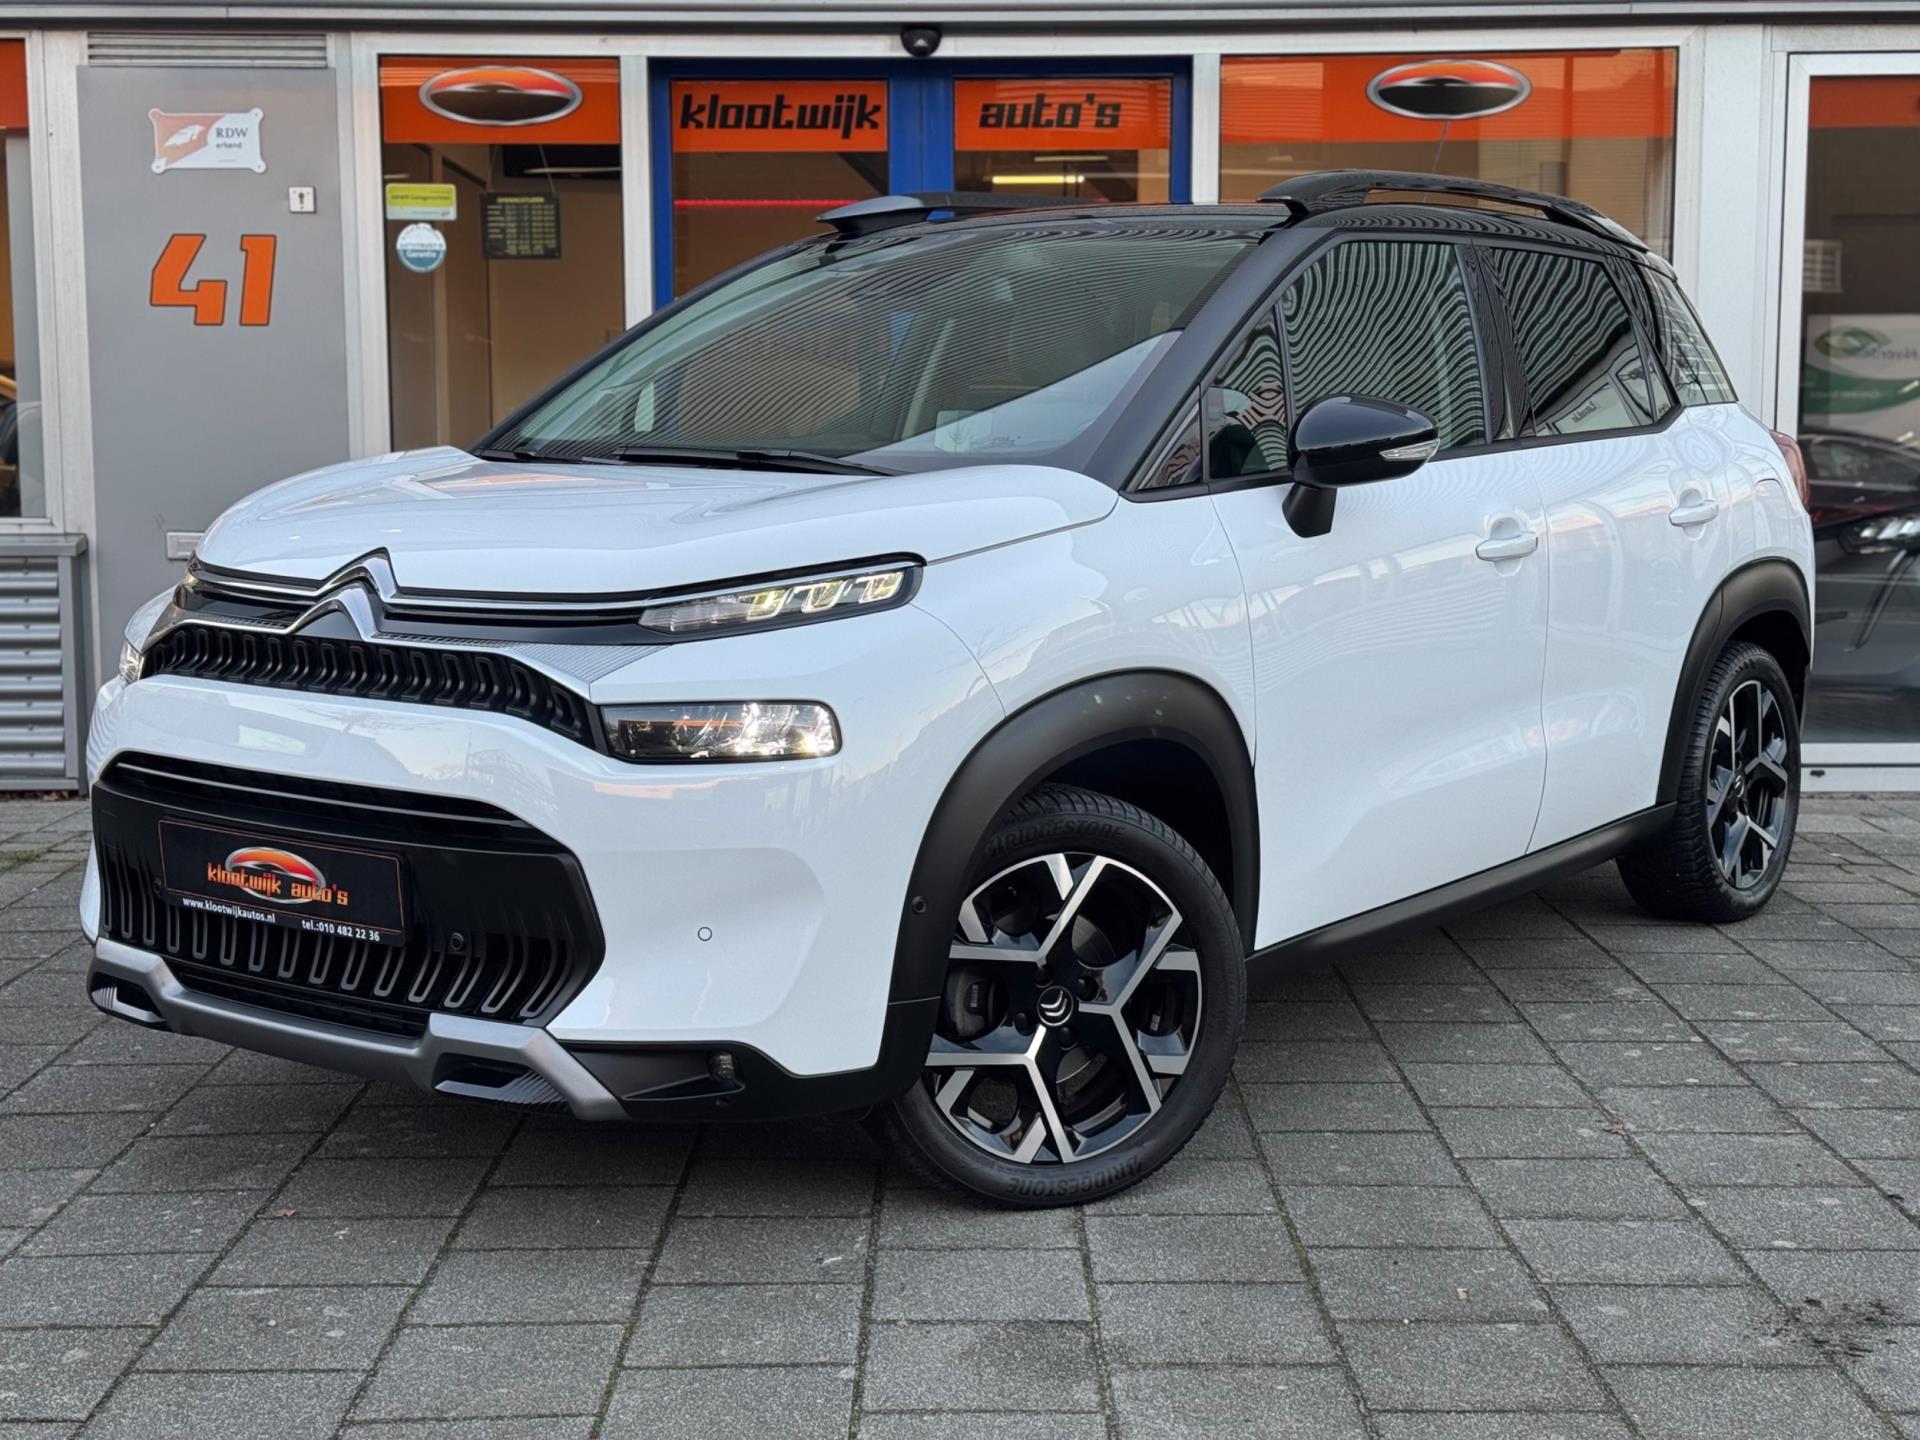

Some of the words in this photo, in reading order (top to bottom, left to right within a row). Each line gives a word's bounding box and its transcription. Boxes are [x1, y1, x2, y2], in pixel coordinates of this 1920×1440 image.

[215, 127, 248, 139] RDW
[680, 94, 881, 139] klootwijk
[979, 93, 1121, 128] auto's
[150, 233, 277, 326] 41
[207, 862, 281, 897] klootwijk
[291, 882, 348, 906] auto's
[182, 897, 275, 923] www.klootwijkautos.nl
[337, 926, 353, 938] 482
[355, 928, 367, 940] 22
[369, 930, 380, 942] 36
